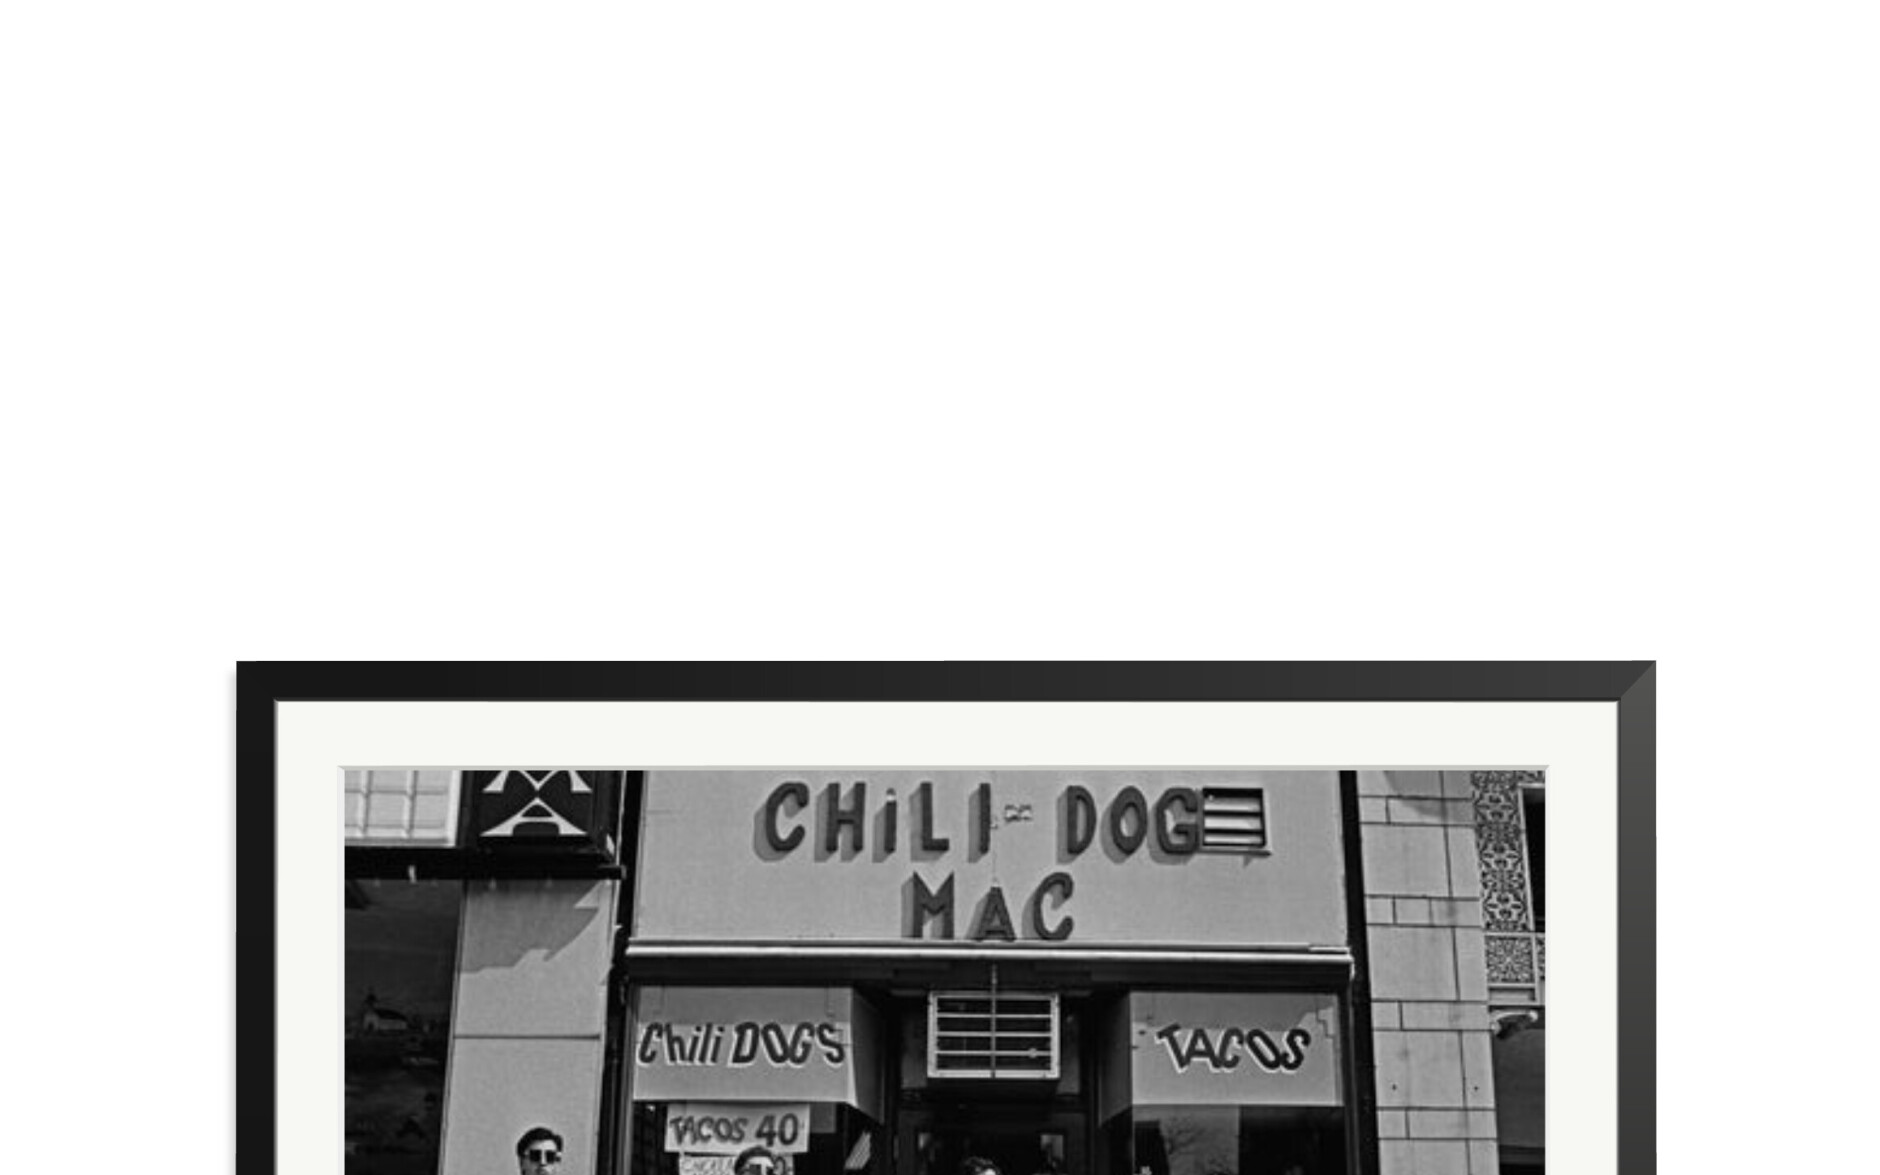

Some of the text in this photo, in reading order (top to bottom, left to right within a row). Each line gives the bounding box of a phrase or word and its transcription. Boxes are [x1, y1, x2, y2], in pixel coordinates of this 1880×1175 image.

[1056, 785, 1199, 864] DOG
[902, 872, 1075, 942] MAC
[637, 1021, 847, 1067] Chili DOGS
[1157, 1023, 1312, 1073] TACOS
[669, 1115, 748, 1146] TACOS
